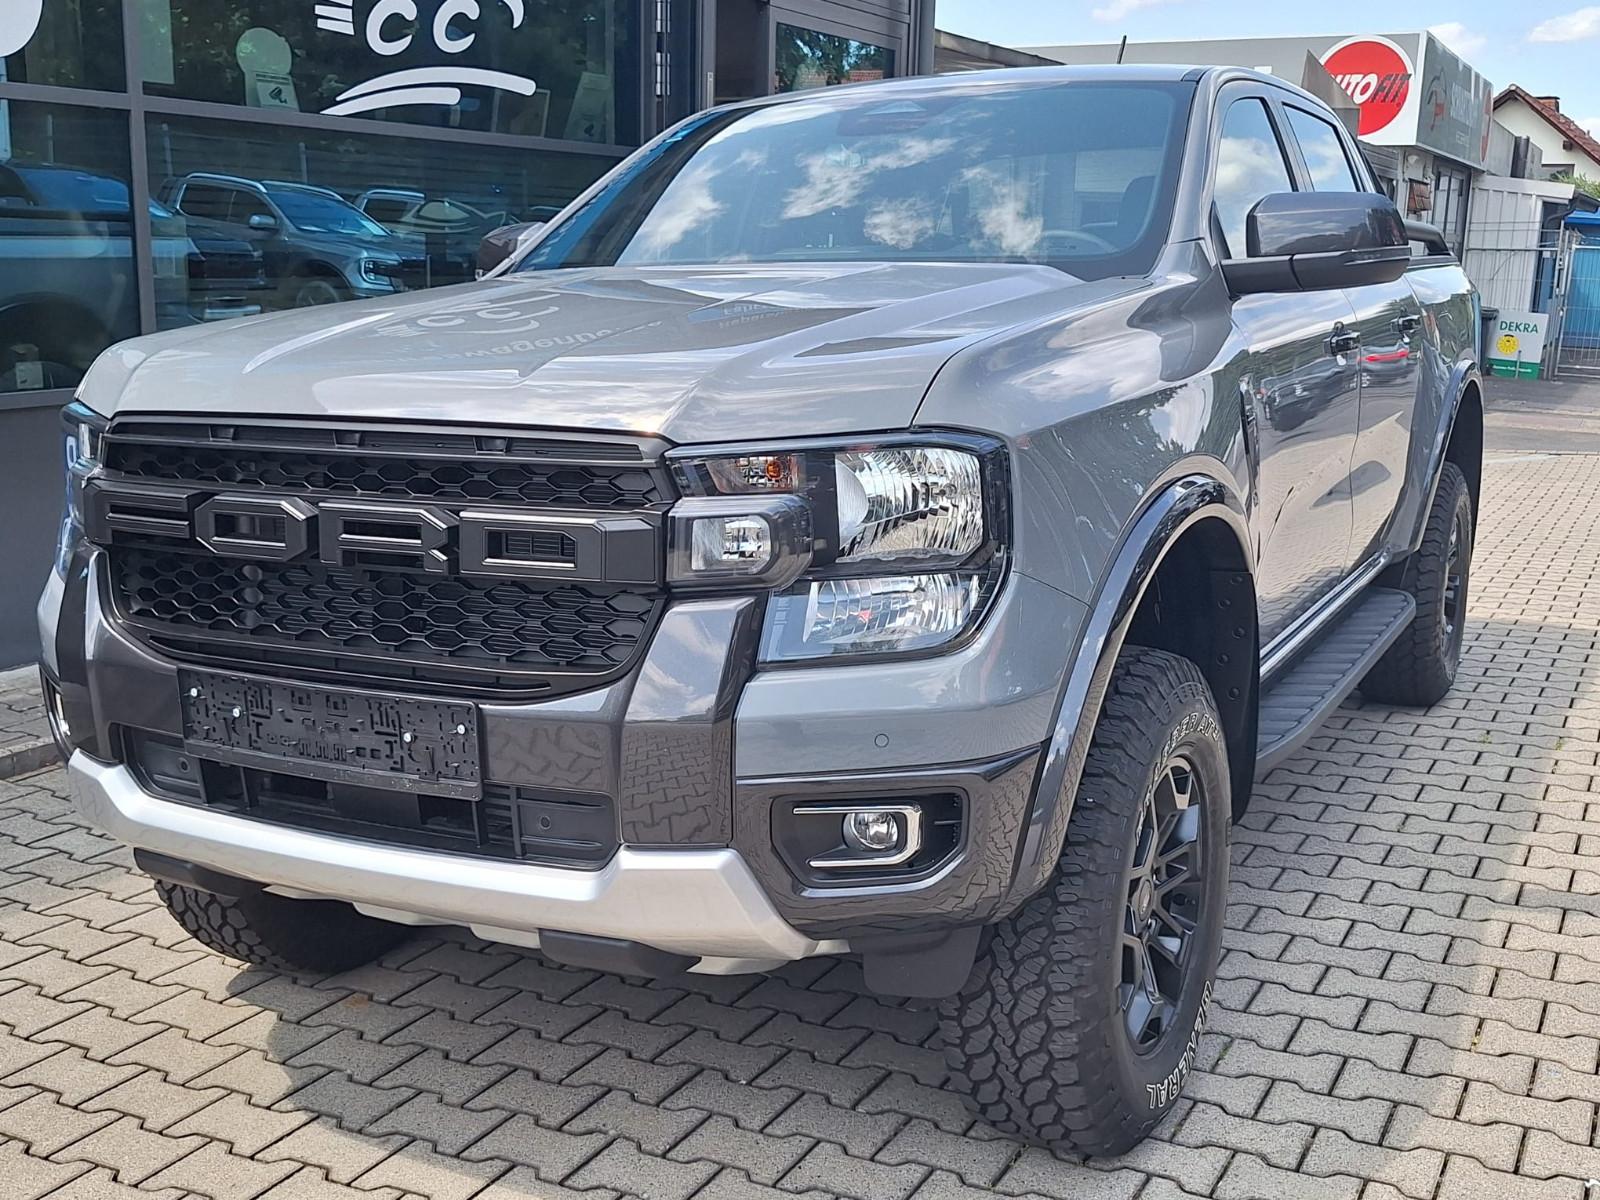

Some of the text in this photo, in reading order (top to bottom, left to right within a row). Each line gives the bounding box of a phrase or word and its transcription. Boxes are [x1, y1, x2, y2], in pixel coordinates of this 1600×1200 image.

[1499, 320, 1539, 334] DEKRA
[88, 480, 612, 582] FORD
[1146, 980, 1213, 1110] GENERAL
